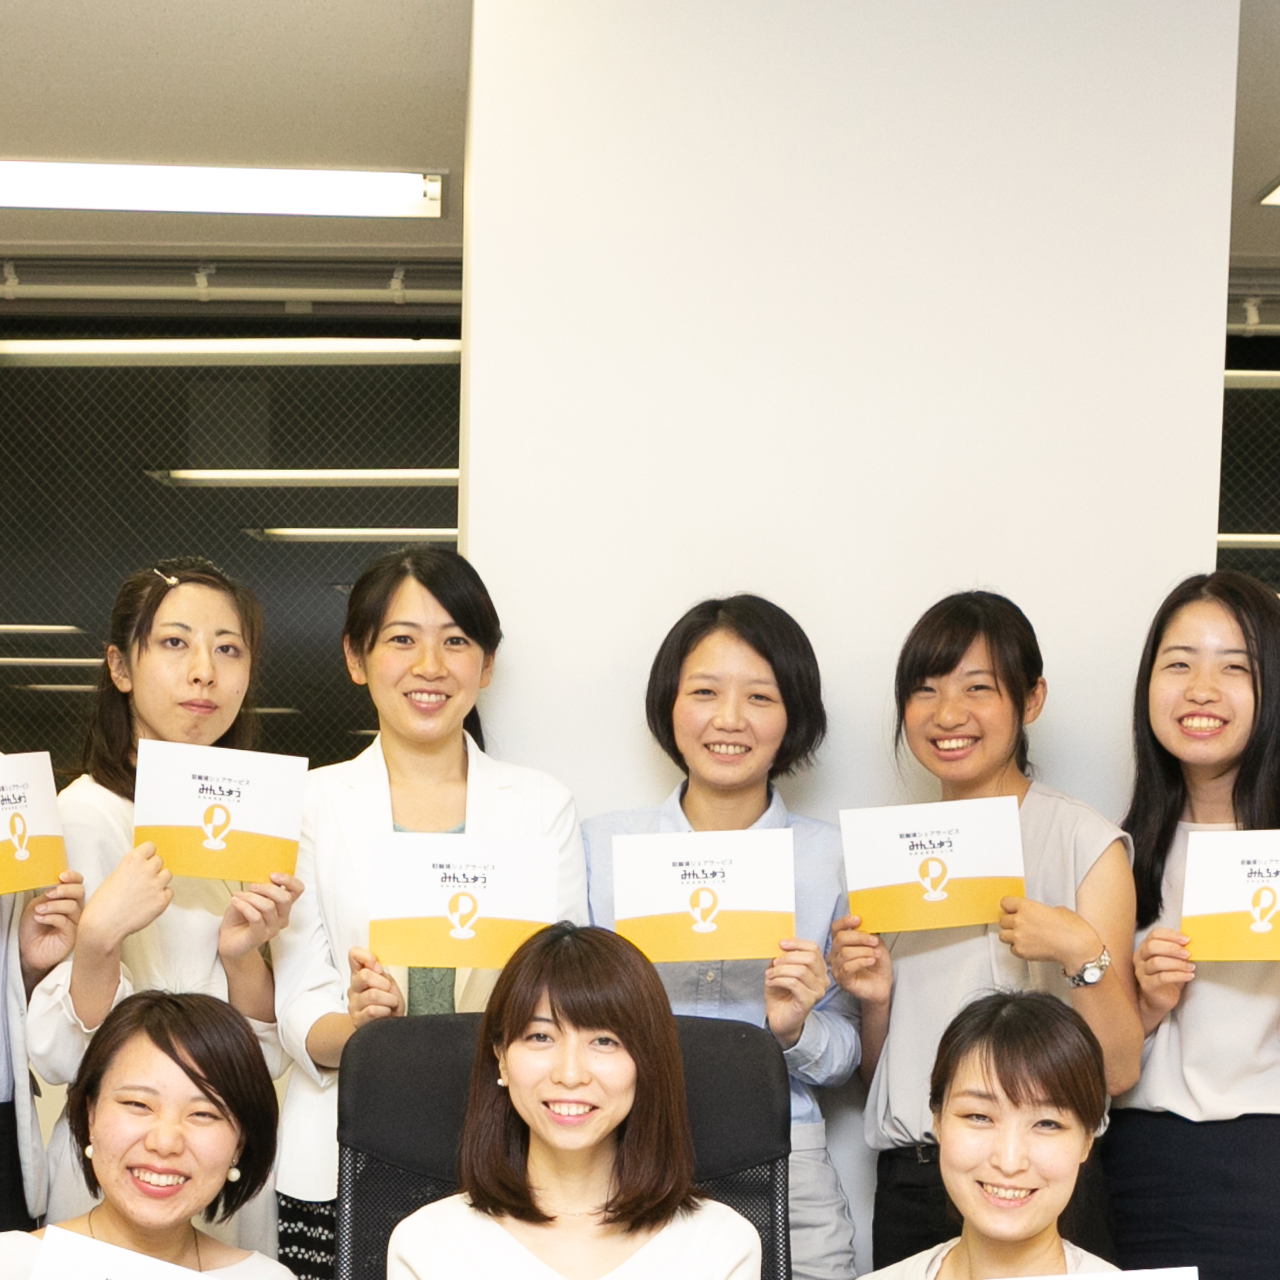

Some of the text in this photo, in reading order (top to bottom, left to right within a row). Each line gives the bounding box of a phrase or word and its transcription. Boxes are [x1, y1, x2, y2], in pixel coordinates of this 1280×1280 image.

[908, 837, 953, 851] みんちゅう
[441, 872, 486, 884] みんちゅう
[681, 868, 725, 880] みんちゅう
